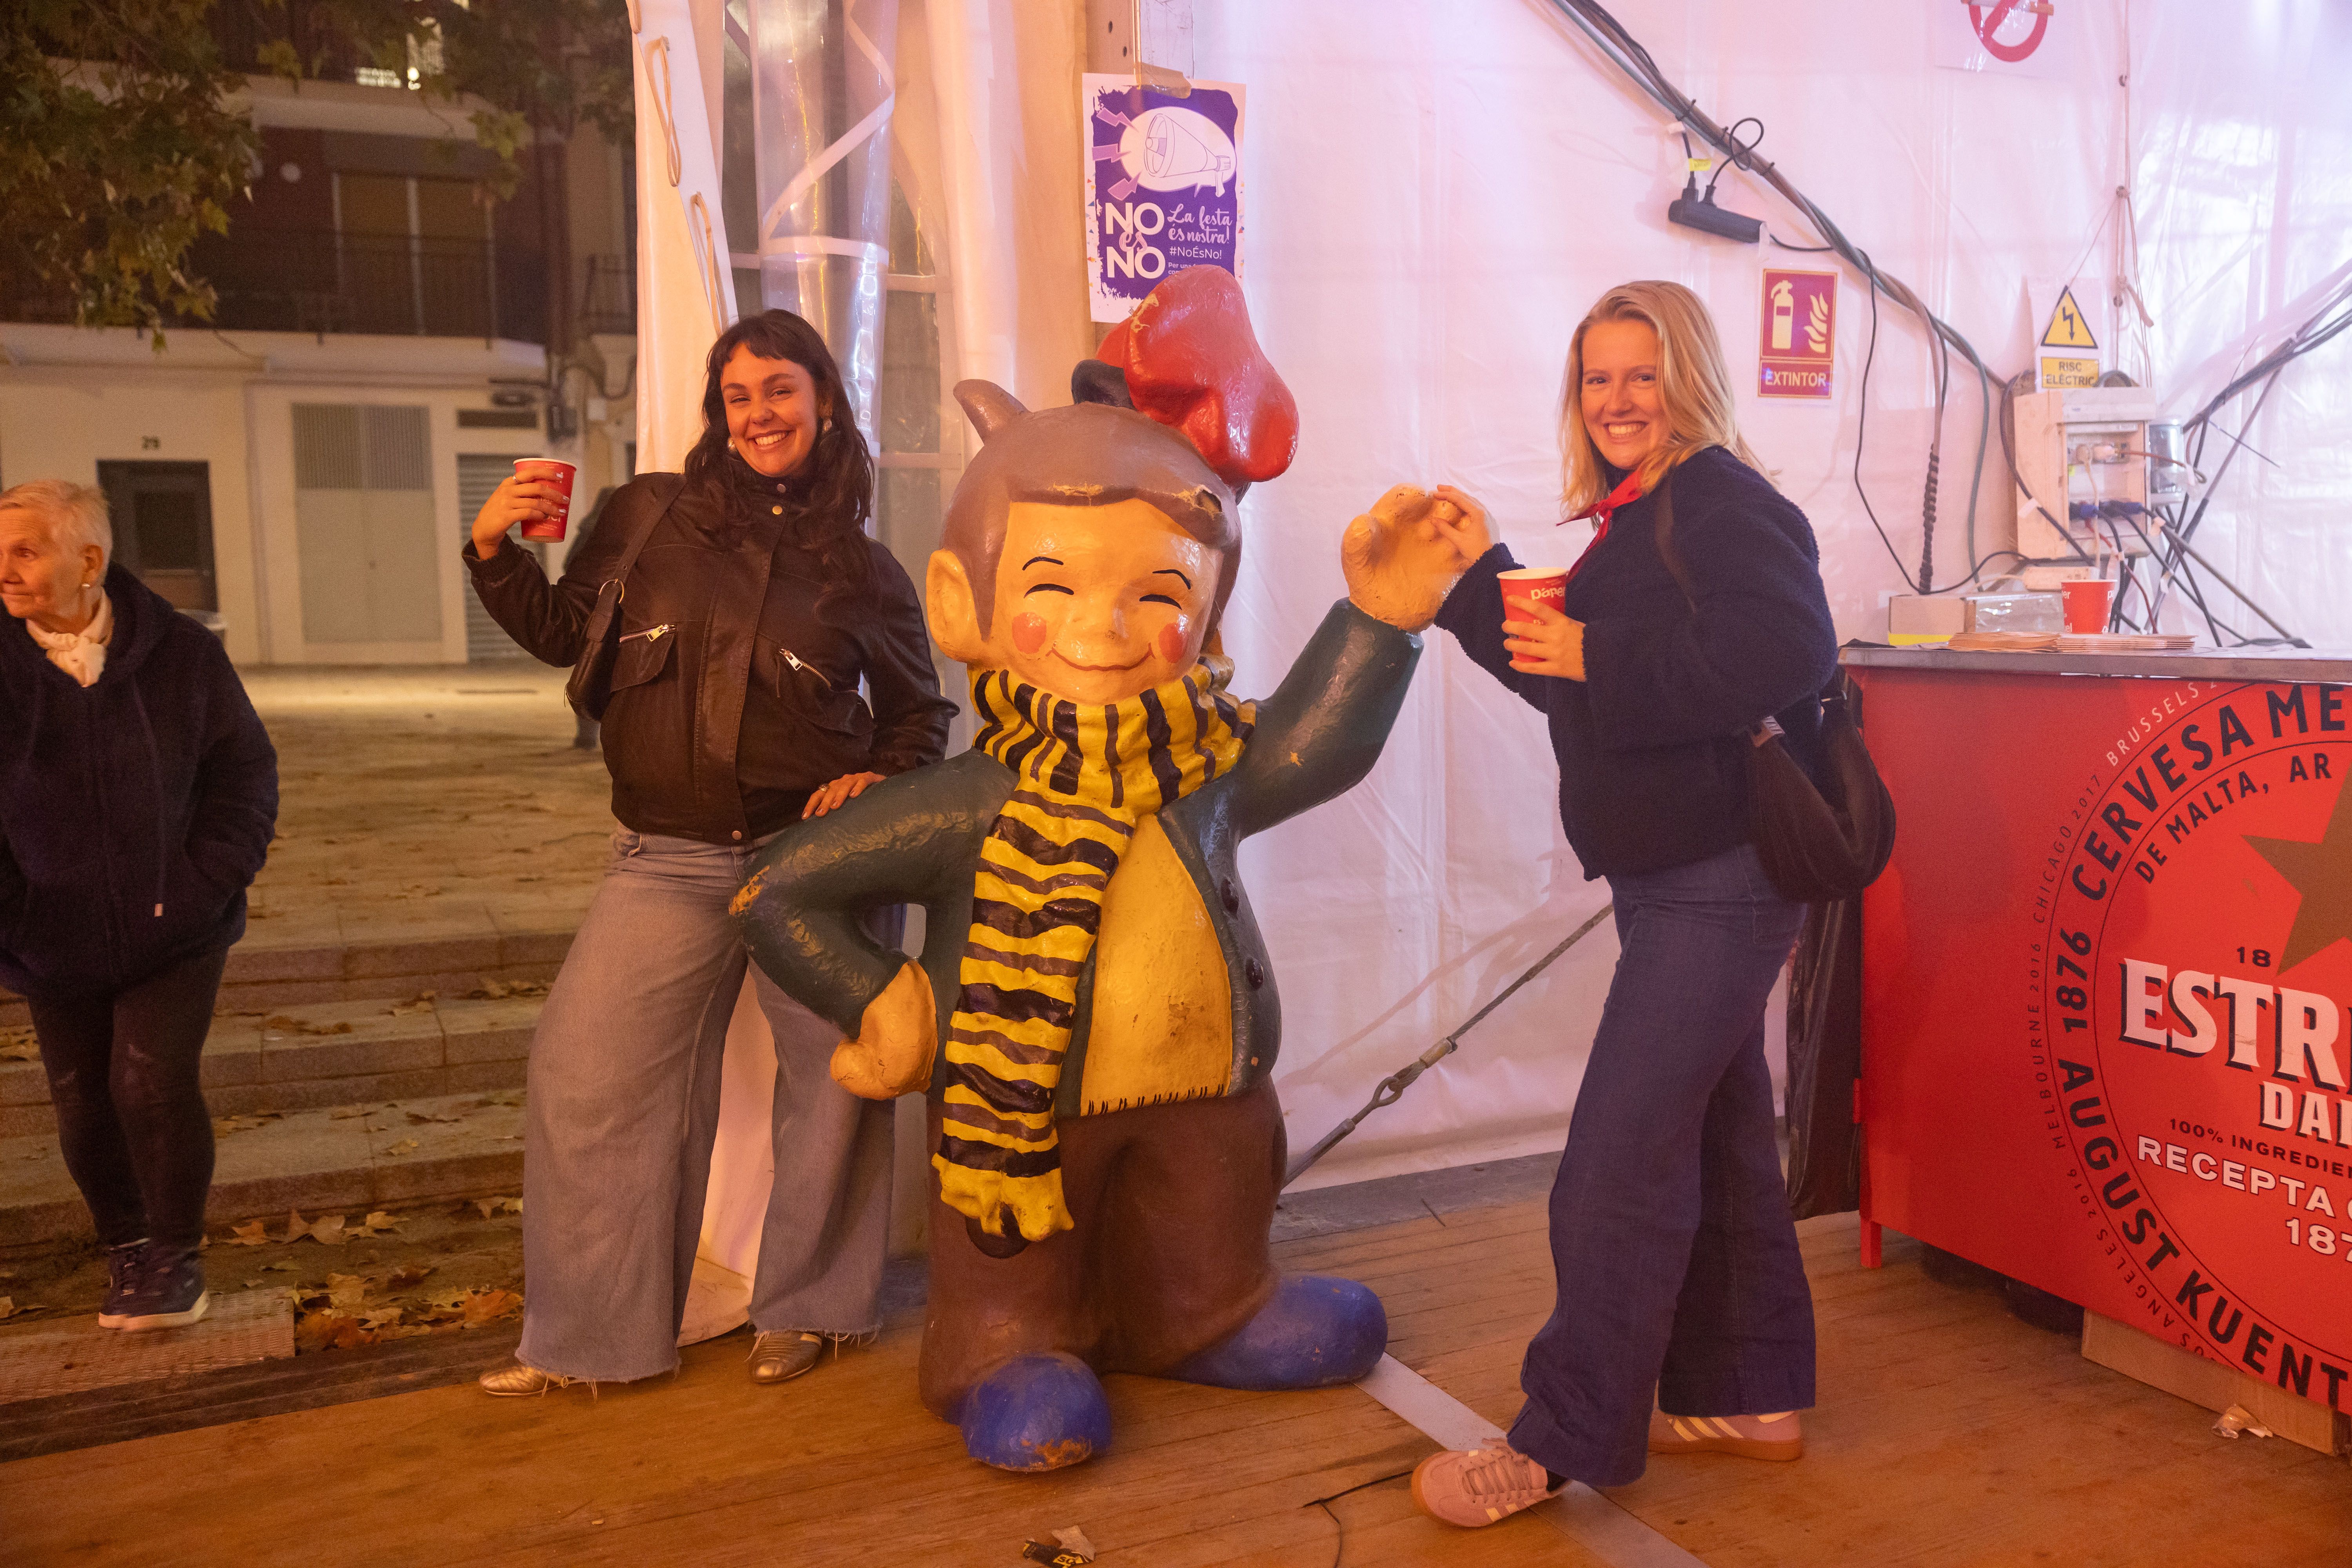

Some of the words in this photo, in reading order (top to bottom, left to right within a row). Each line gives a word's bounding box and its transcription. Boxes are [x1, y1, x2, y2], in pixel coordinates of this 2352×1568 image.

[1105, 202, 1165, 235] NO
[1167, 203, 1195, 223] La
[1199, 206, 1232, 230] festa
[1168, 223, 1185, 241] és
[1187, 225, 1229, 244] nostra!
[1107, 246, 1166, 279] NO
[1169, 246, 1222, 260] #NoÉsNo!
[1765, 371, 1827, 387] EXTINTOR
[2059, 361, 2082, 372] RISC
[2106, 682, 2198, 766] BRUSSELS
[2266, 684, 2345, 738] ME
[2073, 705, 2254, 900] CERVESA
[2135, 846, 2168, 884] DE
[2166, 771, 2269, 844] MALTA,
[2290, 753, 2332, 782] AR
[2034, 826, 2071, 922] CHICAGO
[2073, 775, 2101, 819] 2017
[2031, 943, 2041, 991] 2016
[2056, 928, 2091, 1033] 1876
[2236, 947, 2271, 967] 18
[2119, 958, 2352, 1096] ESTR
[2028, 1005, 2066, 1149] MELBOURNE
[2170, 1119, 2224, 1143] 100%
[2067, 1169, 2096, 1218] 2016
[2138, 1135, 2336, 1218] RECEPTA
[2059, 1059, 2180, 1270] AUGUST
[2175, 1270, 2348, 1410] KUENT
[2097, 1229, 2175, 1327] ANGELES
